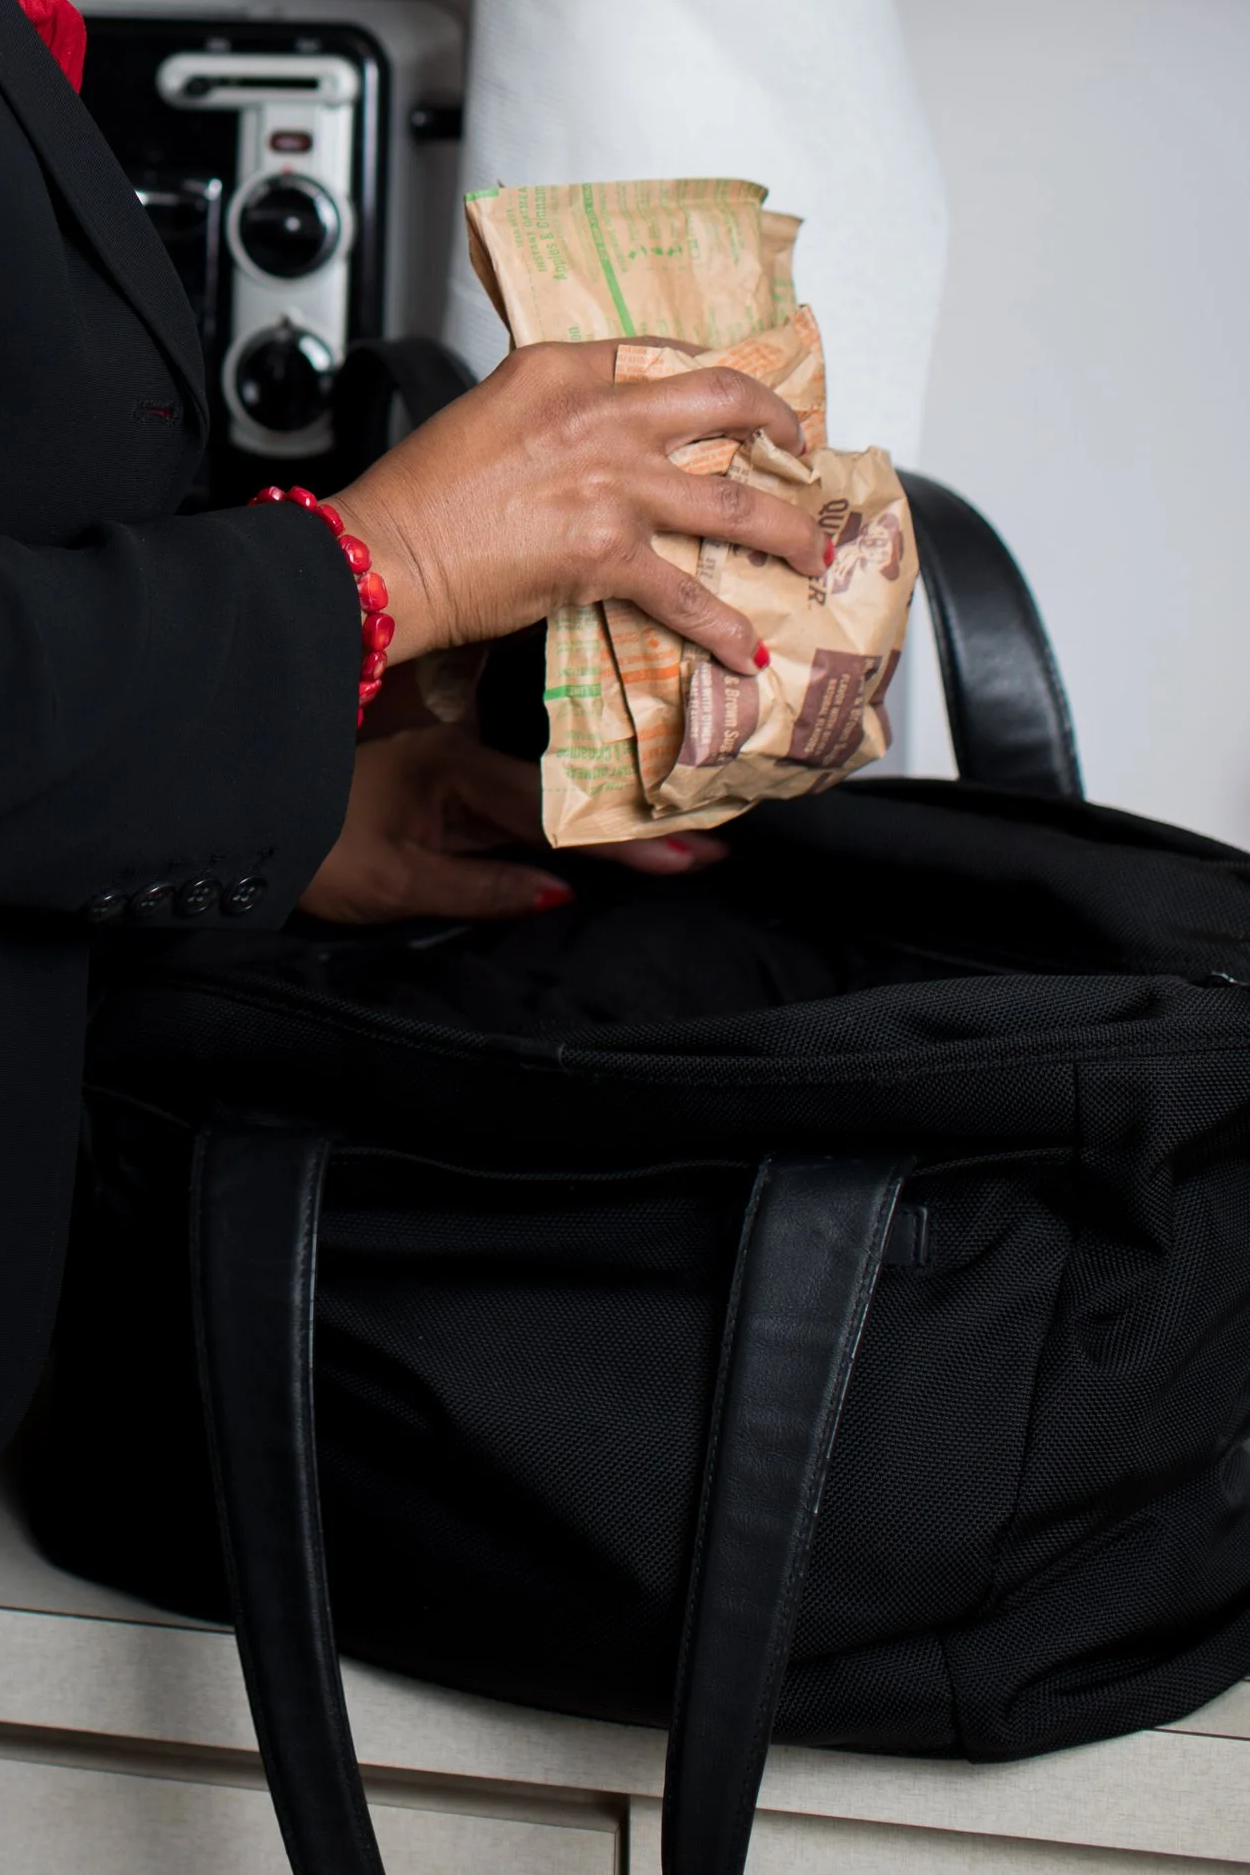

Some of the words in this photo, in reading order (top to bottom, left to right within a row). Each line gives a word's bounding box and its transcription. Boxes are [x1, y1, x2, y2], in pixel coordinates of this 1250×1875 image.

[517, 186, 533, 228] OATMEA
[534, 185, 550, 229] Cinnam
[539, 232, 554, 241] &
[546, 242, 568, 280] Apples
[808, 498, 849, 606] QUR
[724, 688, 740, 728] Brown
[717, 729, 740, 762] Sugr
